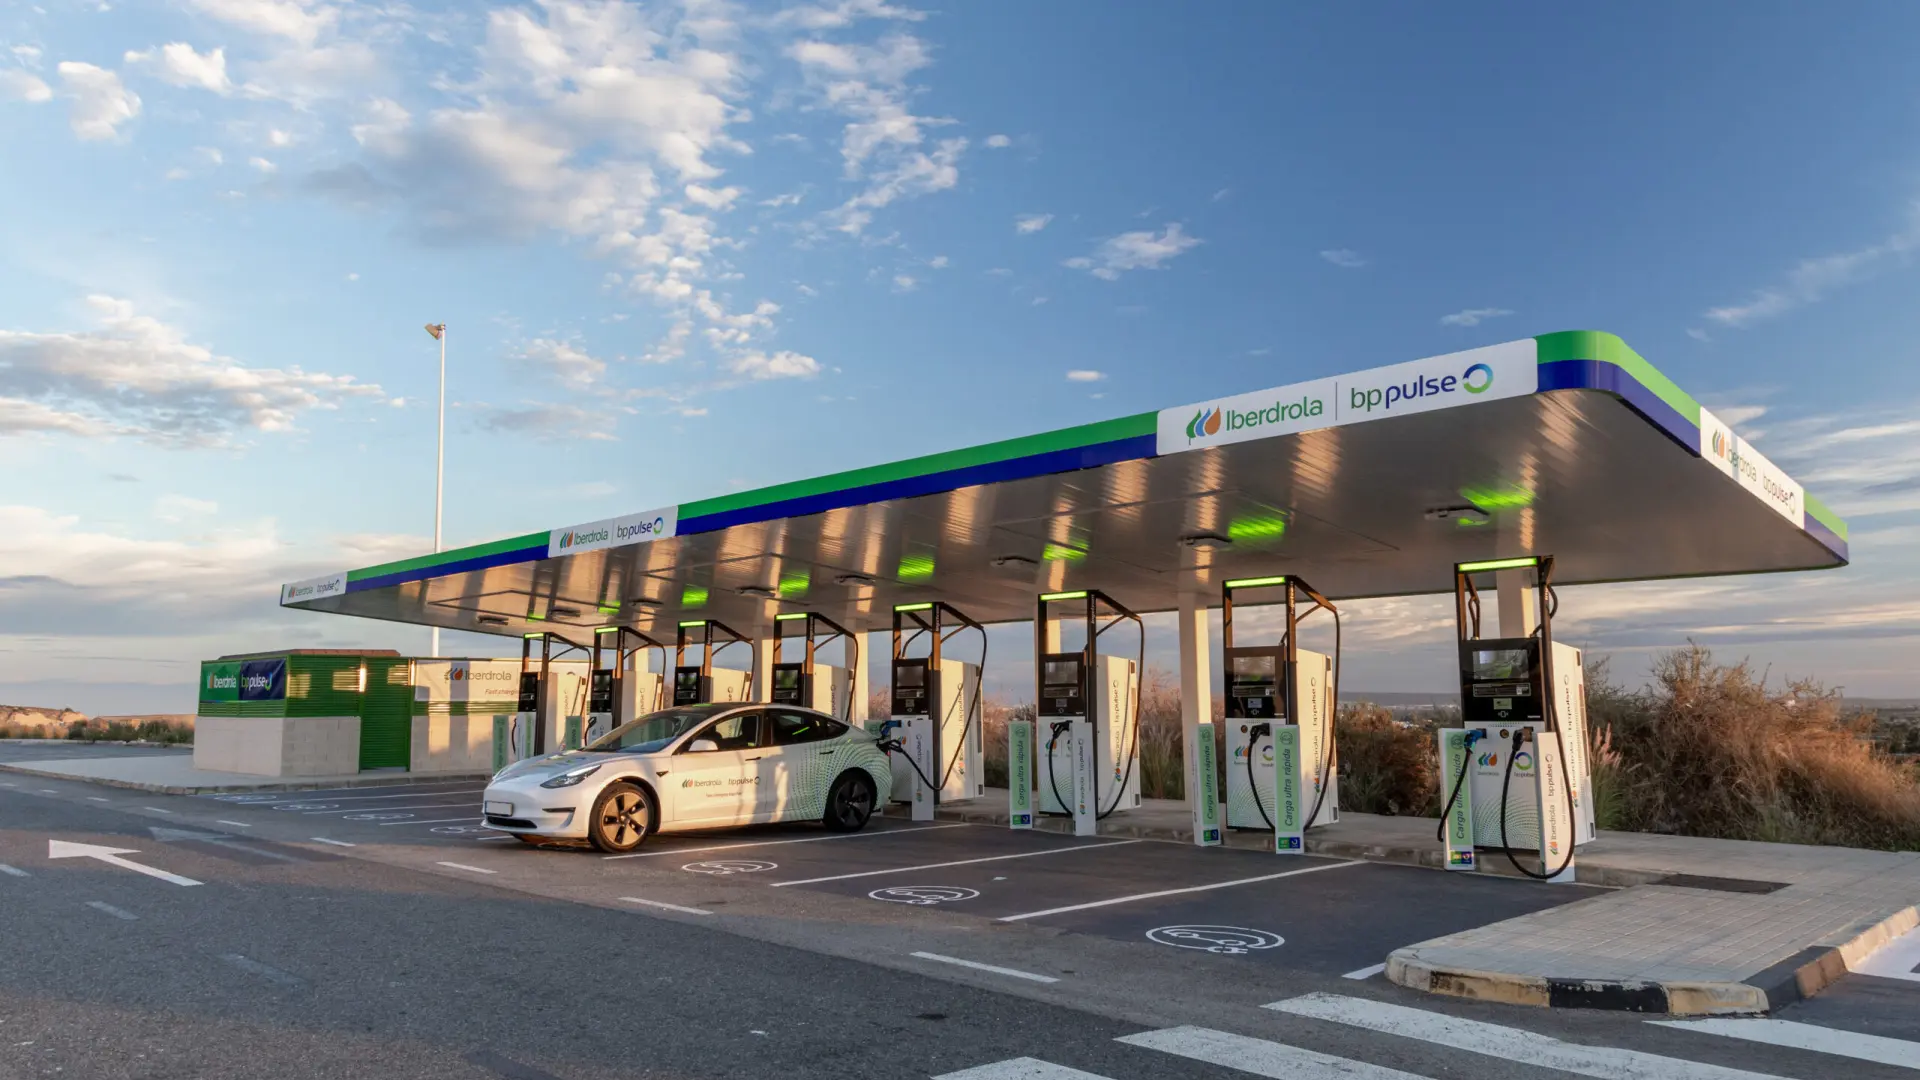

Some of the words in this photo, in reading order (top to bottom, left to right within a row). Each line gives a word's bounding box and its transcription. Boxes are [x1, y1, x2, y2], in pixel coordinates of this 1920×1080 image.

[1226, 396, 1323, 431] Iberdrola
[574, 528, 609, 546] Iberdrola
[465, 670, 512, 681] Iberdrola
[1283, 748, 1292, 776] rápida
[1284, 779, 1292, 798] ultra
[1206, 795, 1214, 820] Carga
[1284, 801, 1294, 826] Carga
[1456, 811, 1465, 840] Carga
[1549, 804, 1557, 841] Iberdrola
